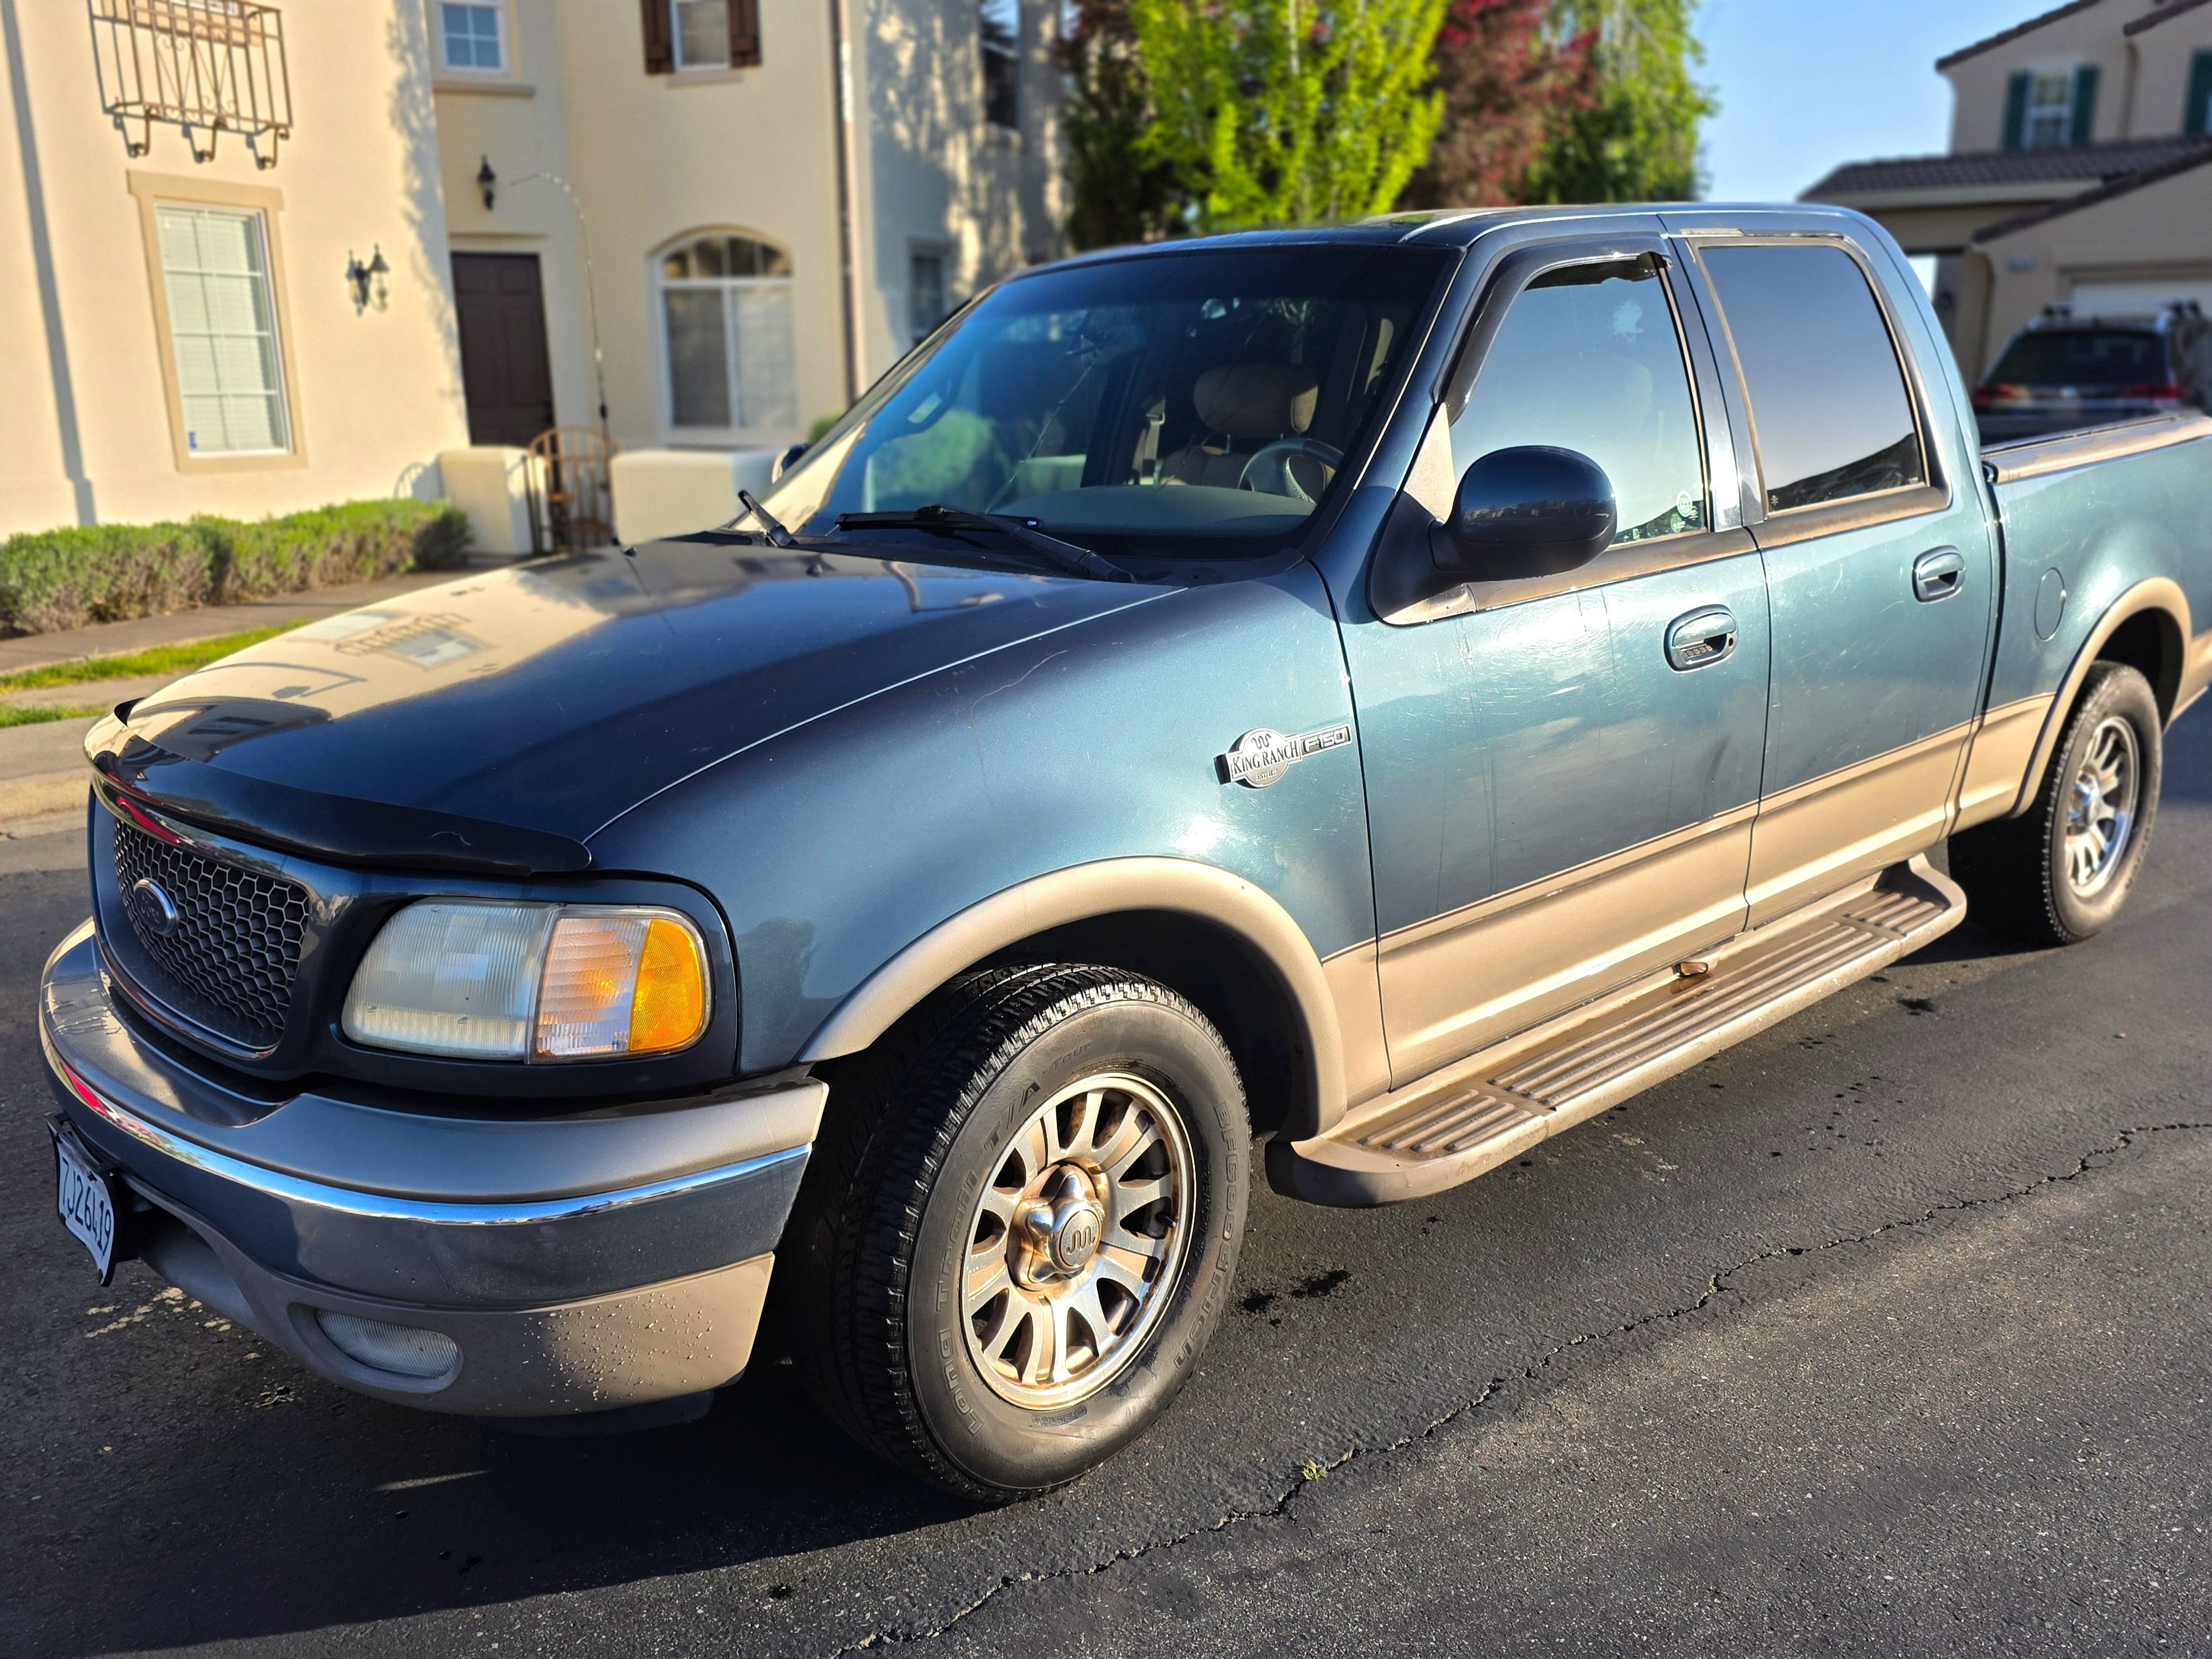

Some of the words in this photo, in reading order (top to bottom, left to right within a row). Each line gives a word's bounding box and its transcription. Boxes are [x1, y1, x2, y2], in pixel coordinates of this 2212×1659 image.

[1232, 754, 1260, 774] KING
[1262, 740, 1298, 766] RANCH
[983, 1079, 1042, 1152] T/A
[62, 1156, 111, 1256] 7J26419
[936, 1170, 979, 1312] Trail
[938, 1328, 983, 1436] Long
